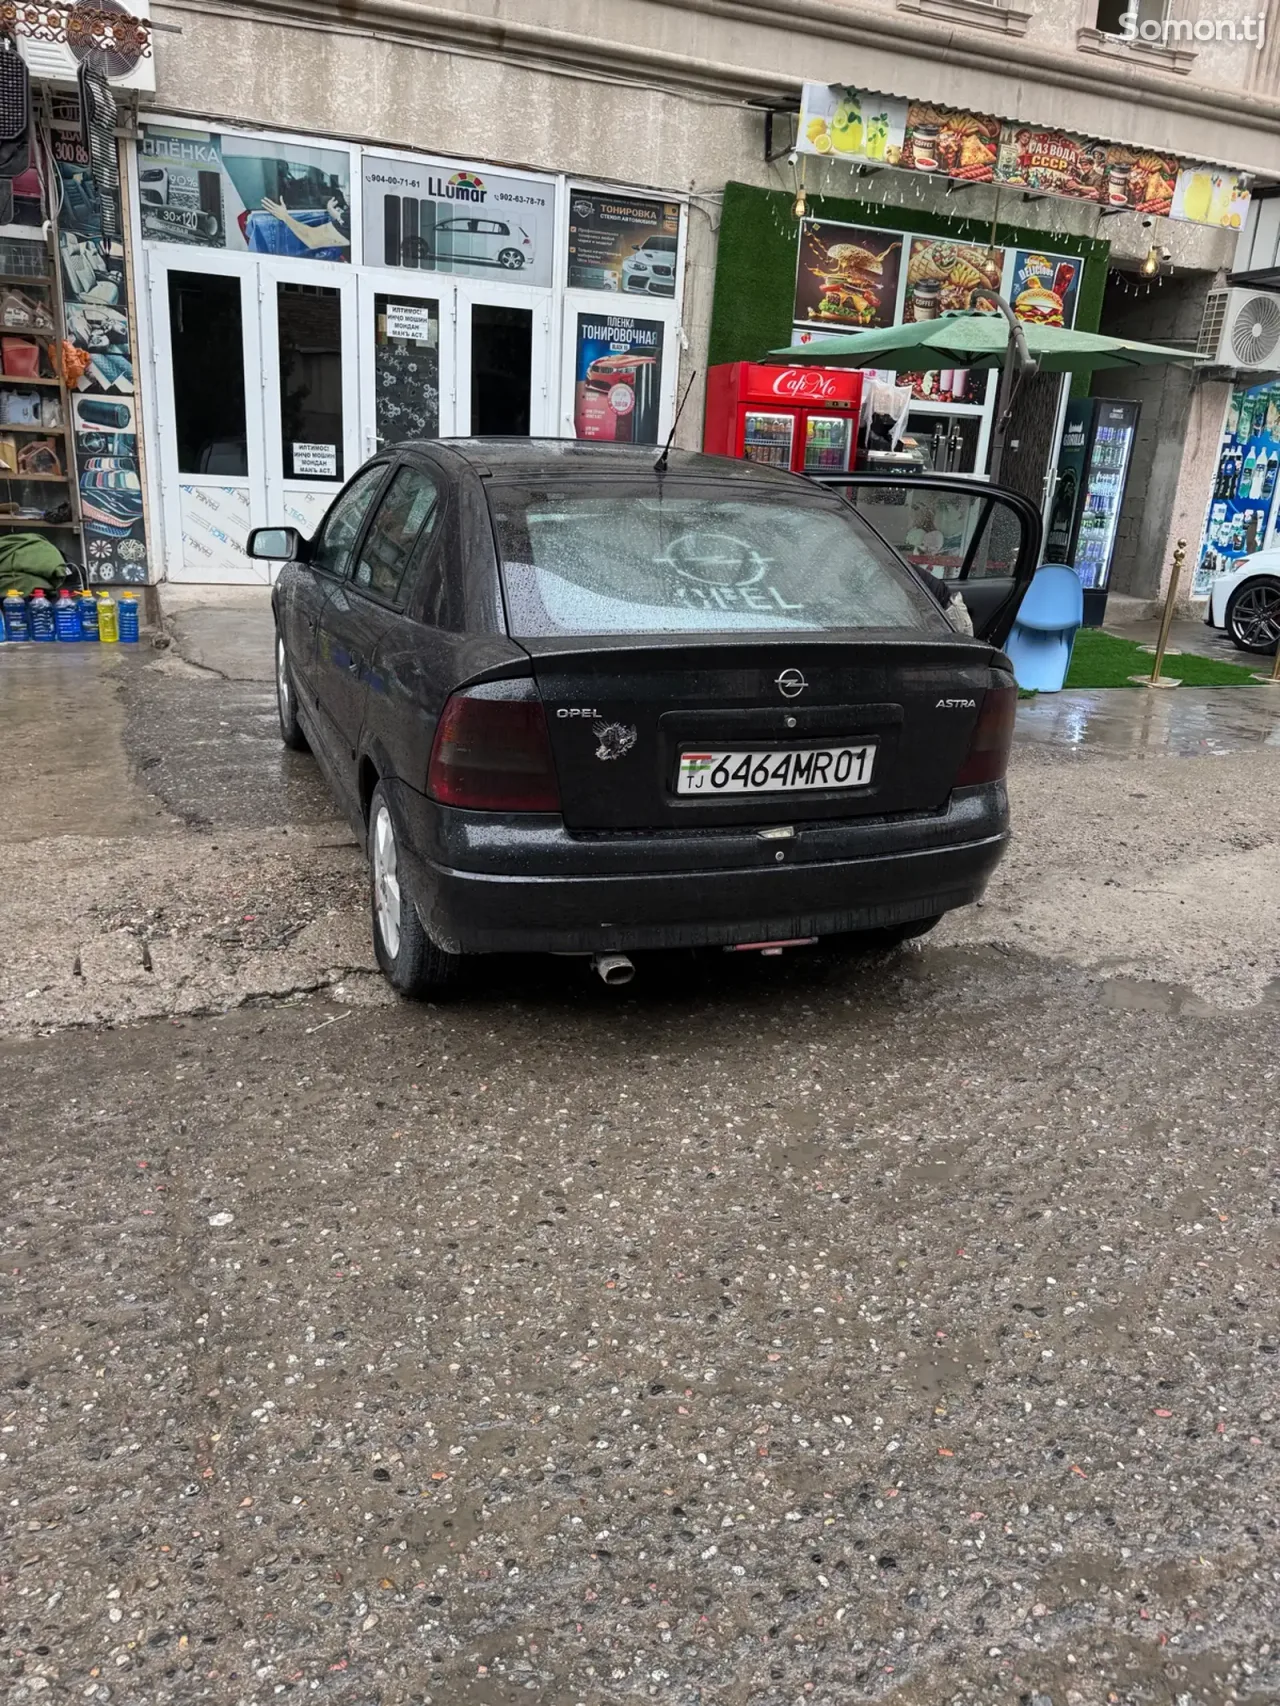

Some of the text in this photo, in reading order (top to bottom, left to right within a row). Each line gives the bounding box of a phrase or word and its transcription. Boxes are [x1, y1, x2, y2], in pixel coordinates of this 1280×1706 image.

[914, 139, 934, 148] COFFEE
[143, 138, 220, 163] ПЛЁНКА
[1049, 144, 1077, 163] ВОДА
[1031, 155, 1068, 170] СССР
[170, 174, 198, 187] 90%
[371, 173, 420, 188] 904-00-71-61
[428, 176, 487, 203] LLumar
[499, 193, 545, 206] 902-63-78-78
[600, 204, 657, 219] ТОНИРОВКА
[915, 298, 935, 307] COFFEE
[607, 316, 634, 328] ПЛЕНКА
[582, 324, 658, 345] ТОНИРОВОЧНАЯ
[1063, 433, 1085, 446] GORILLA
[936, 699, 976, 708] ASTRA
[556, 708, 602, 718] OPEL
[710, 748, 867, 788] 6464MR01
[687, 776, 704, 788] TJ
